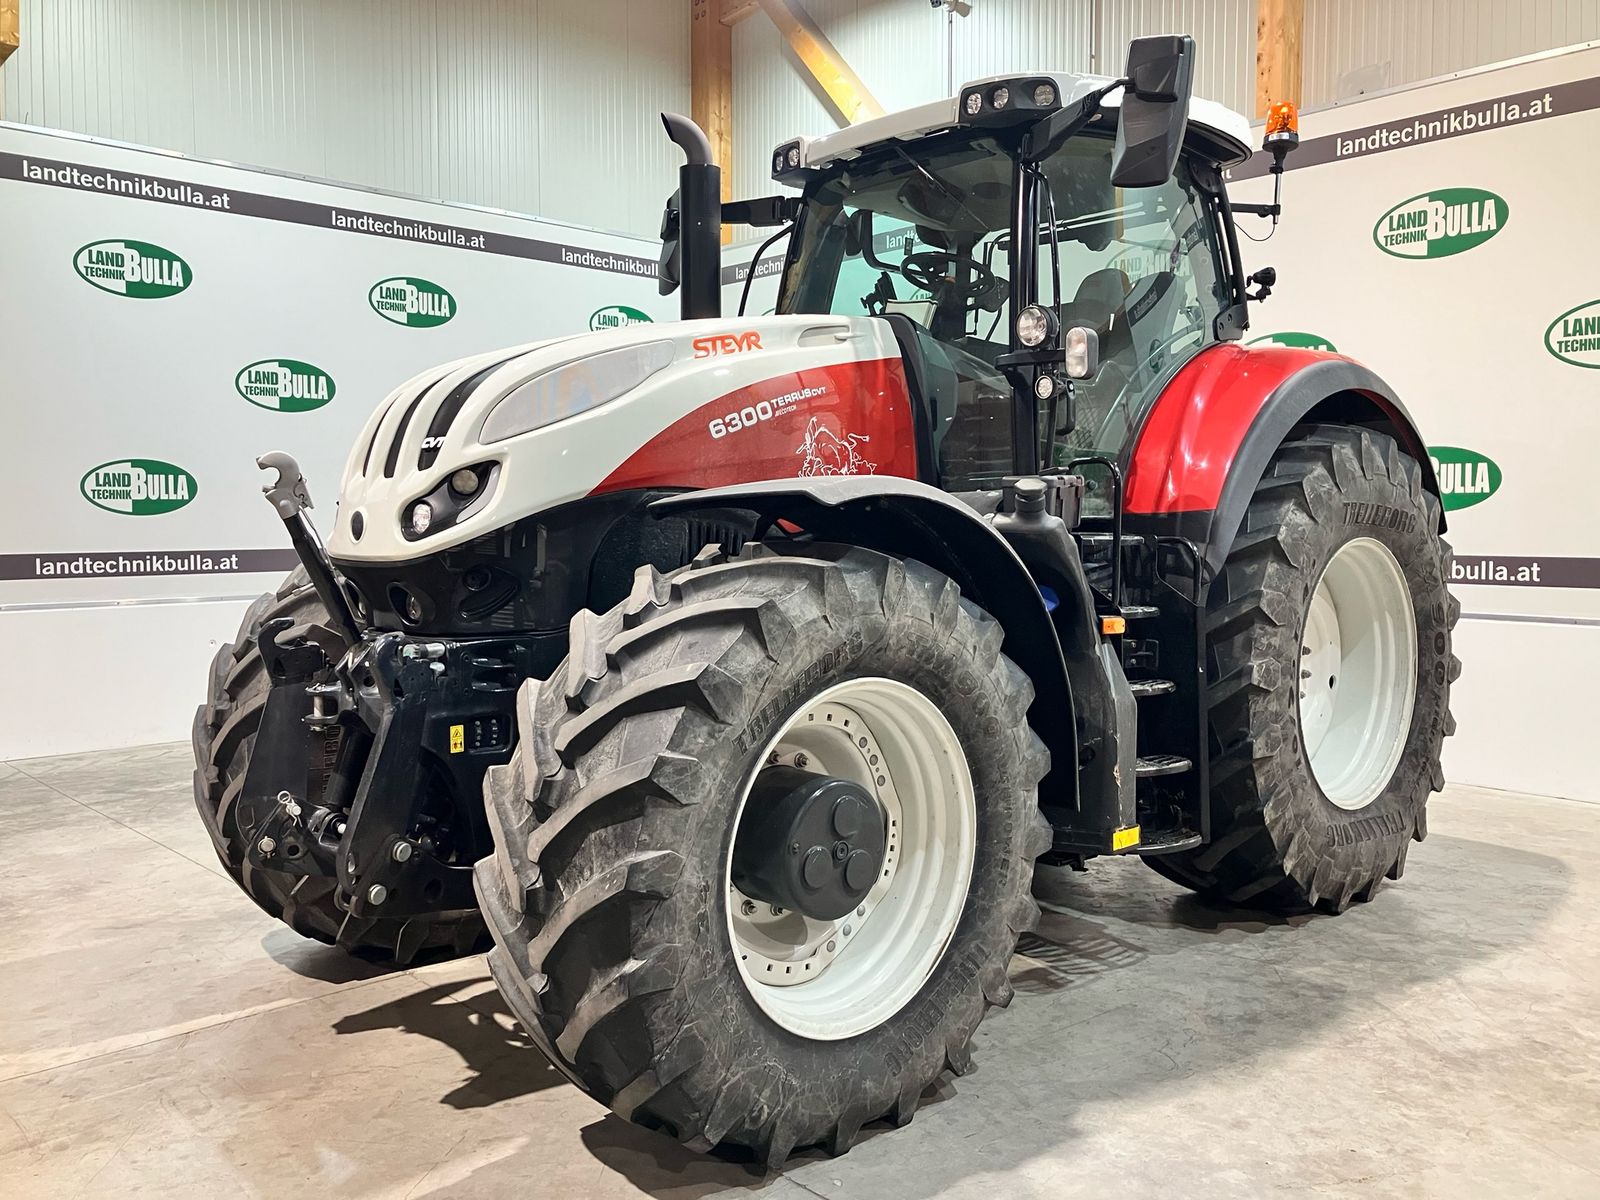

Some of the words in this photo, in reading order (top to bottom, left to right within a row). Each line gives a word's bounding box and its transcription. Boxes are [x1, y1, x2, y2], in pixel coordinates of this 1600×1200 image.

[1336, 92, 1553, 157] landtechnikbulla.at
[22, 159, 231, 209] landtechnikbulla.at
[332, 210, 486, 249] landtechnikbulla.at
[1388, 209, 1428, 233] LAND
[1427, 198, 1497, 241] BULLA
[1383, 229, 1428, 247] TECHNIK
[87, 249, 125, 268] LAND
[124, 247, 184, 288] BULLA
[735, 256, 785, 280] lantechni
[84, 265, 126, 281] TECHNIK
[379, 286, 407, 302] LAND
[406, 284, 451, 318] BULLA
[376, 299, 407, 313] TECHNIK
[598, 314, 619, 328] LAND
[692, 331, 763, 359] STEYR
[248, 370, 279, 386] LAND
[278, 367, 329, 400] BULLA
[244, 385, 279, 397] TECHNIK
[708, 401, 774, 440] 6300
[771, 388, 811, 409] TERRUS
[810, 386, 827, 397] CVT
[421, 436, 447, 449] CVT
[95, 472, 131, 488] LAND
[131, 467, 189, 501] BULLA
[91, 489, 132, 500] TECHNIK
[35, 553, 239, 576] landtechnikbulla.at
[1448, 560, 1541, 582] bulla.at
